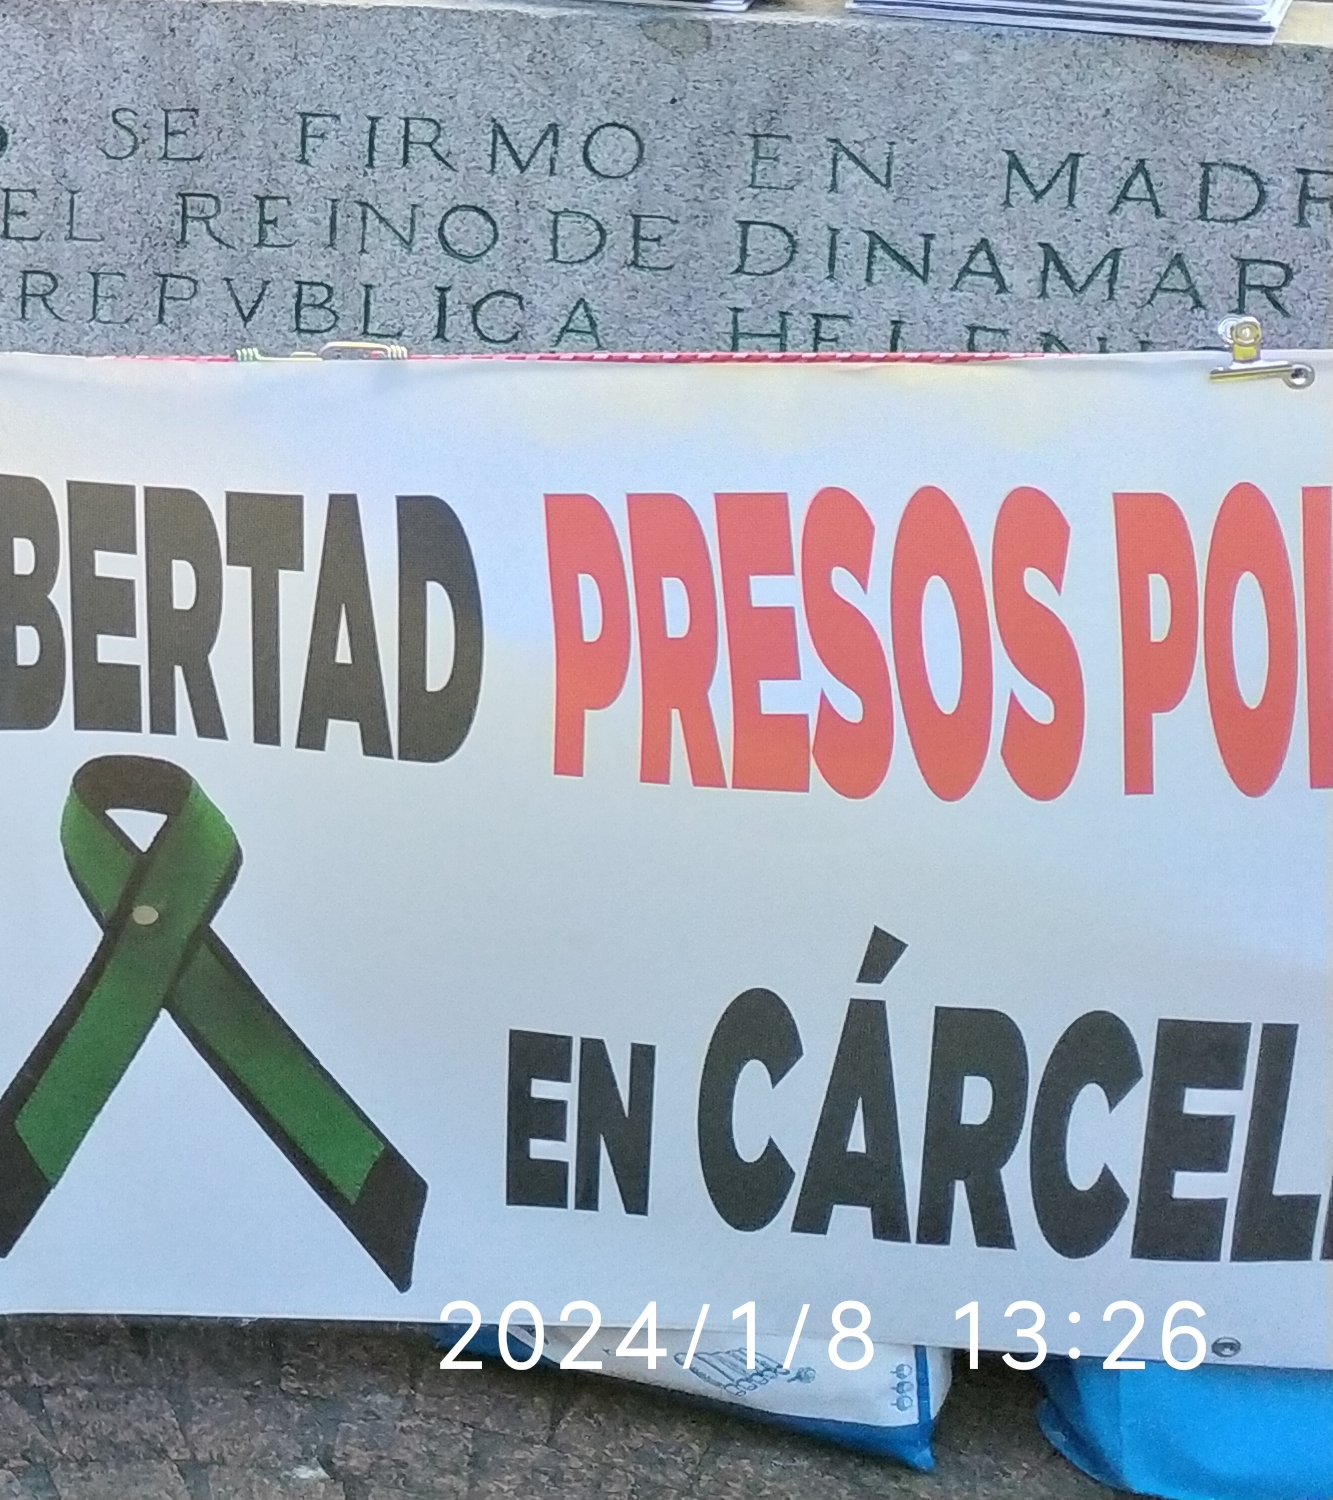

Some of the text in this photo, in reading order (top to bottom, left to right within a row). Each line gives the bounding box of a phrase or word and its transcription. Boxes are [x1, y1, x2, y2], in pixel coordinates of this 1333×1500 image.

[98, 106, 204, 163] SE
[294, 111, 645, 179] FIRMO
[746, 133, 897, 194] EN
[17, 269, 607, 351] REPVBLICA
[175, 191, 500, 263] REINO
[546, 208, 680, 272] DE
[731, 218, 1293, 319] DINAMAR
[544, 484, 1086, 802] PRESOS
[506, 924, 1333, 1262] EN CÁRCEL
